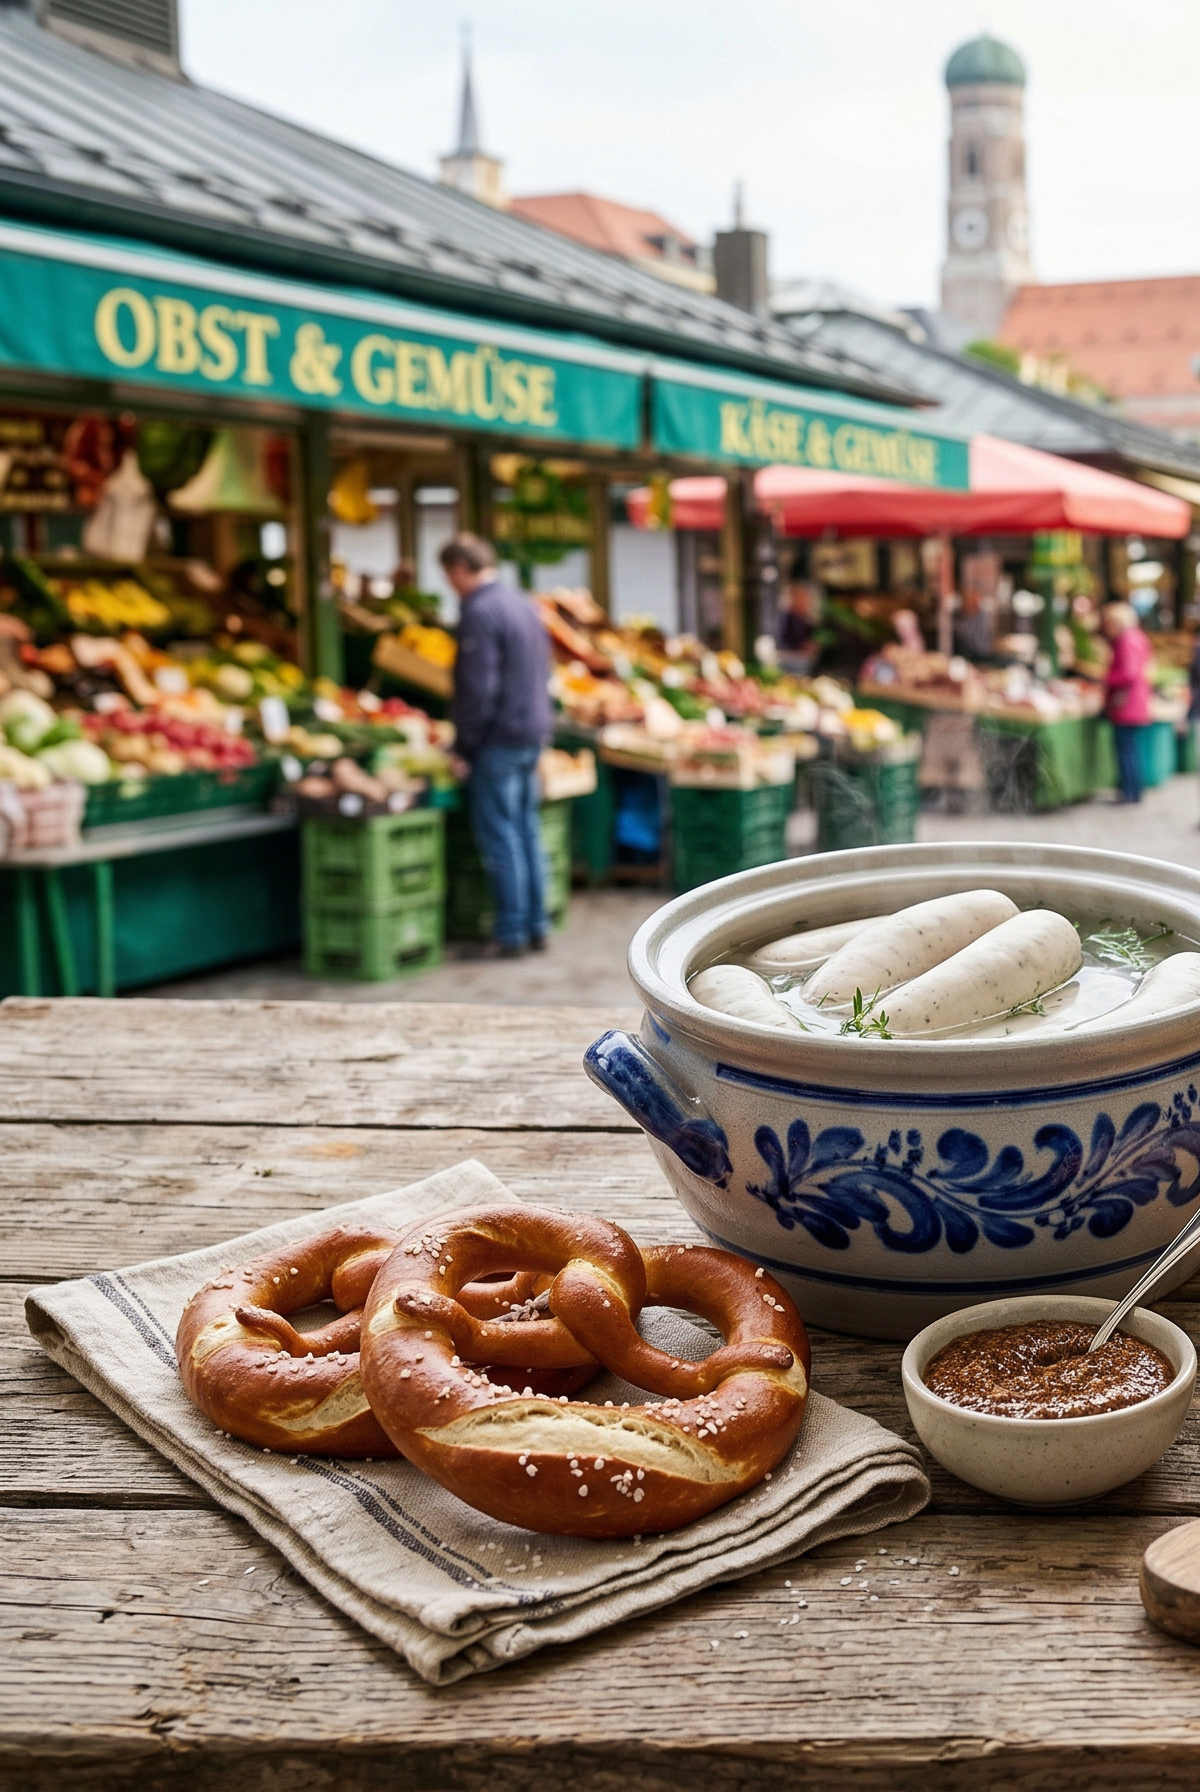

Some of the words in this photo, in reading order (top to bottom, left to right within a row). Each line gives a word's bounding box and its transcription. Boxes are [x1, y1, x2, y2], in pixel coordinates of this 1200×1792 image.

[95, 287, 280, 386] OBST
[289, 323, 344, 397] &
[350, 334, 559, 427] GEMÜSE
